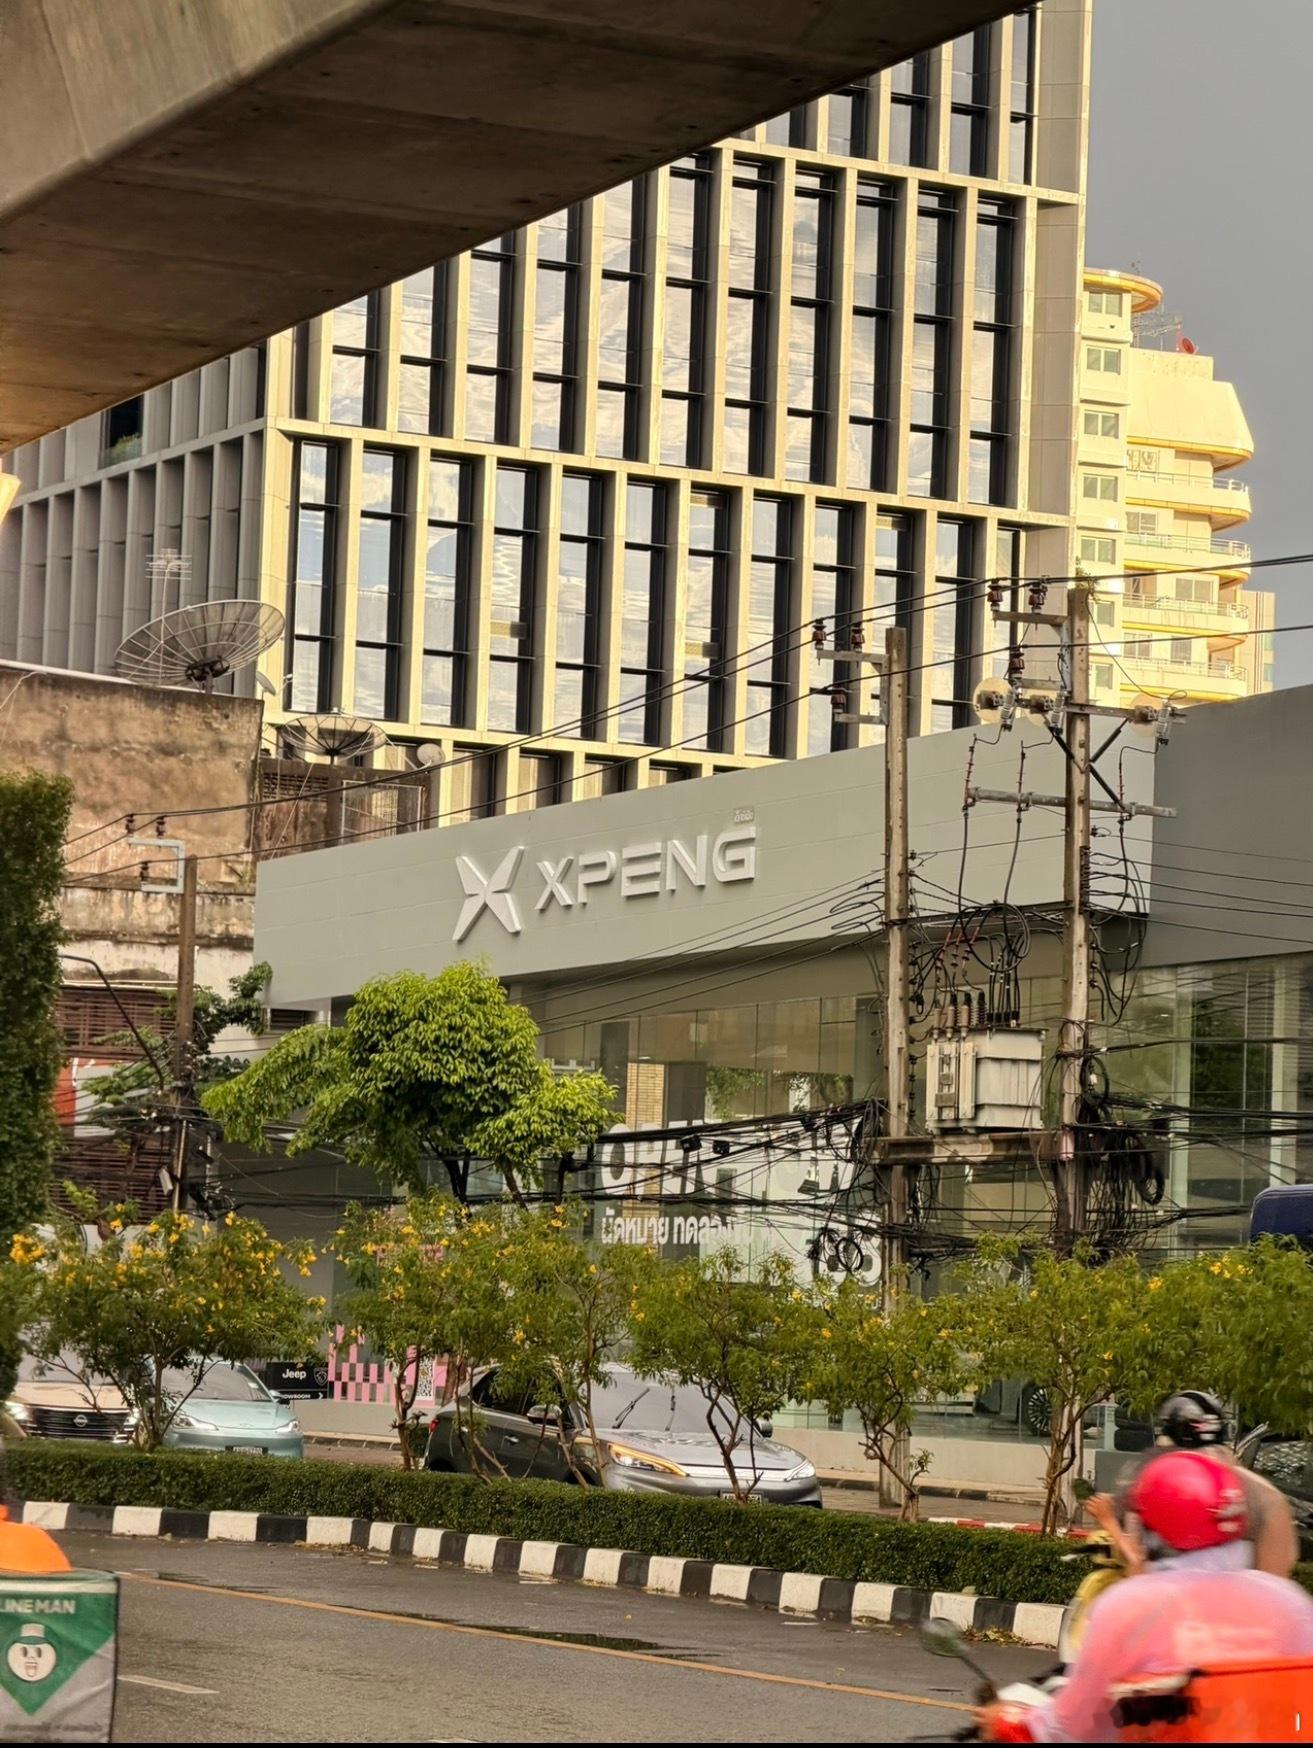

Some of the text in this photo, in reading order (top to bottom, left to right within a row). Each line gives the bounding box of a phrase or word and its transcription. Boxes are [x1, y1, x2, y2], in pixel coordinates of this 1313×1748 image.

[535, 827, 757, 912] XPENG
[282, 1369, 307, 1380] Jeep
[35, 1599, 76, 1614] MAN
